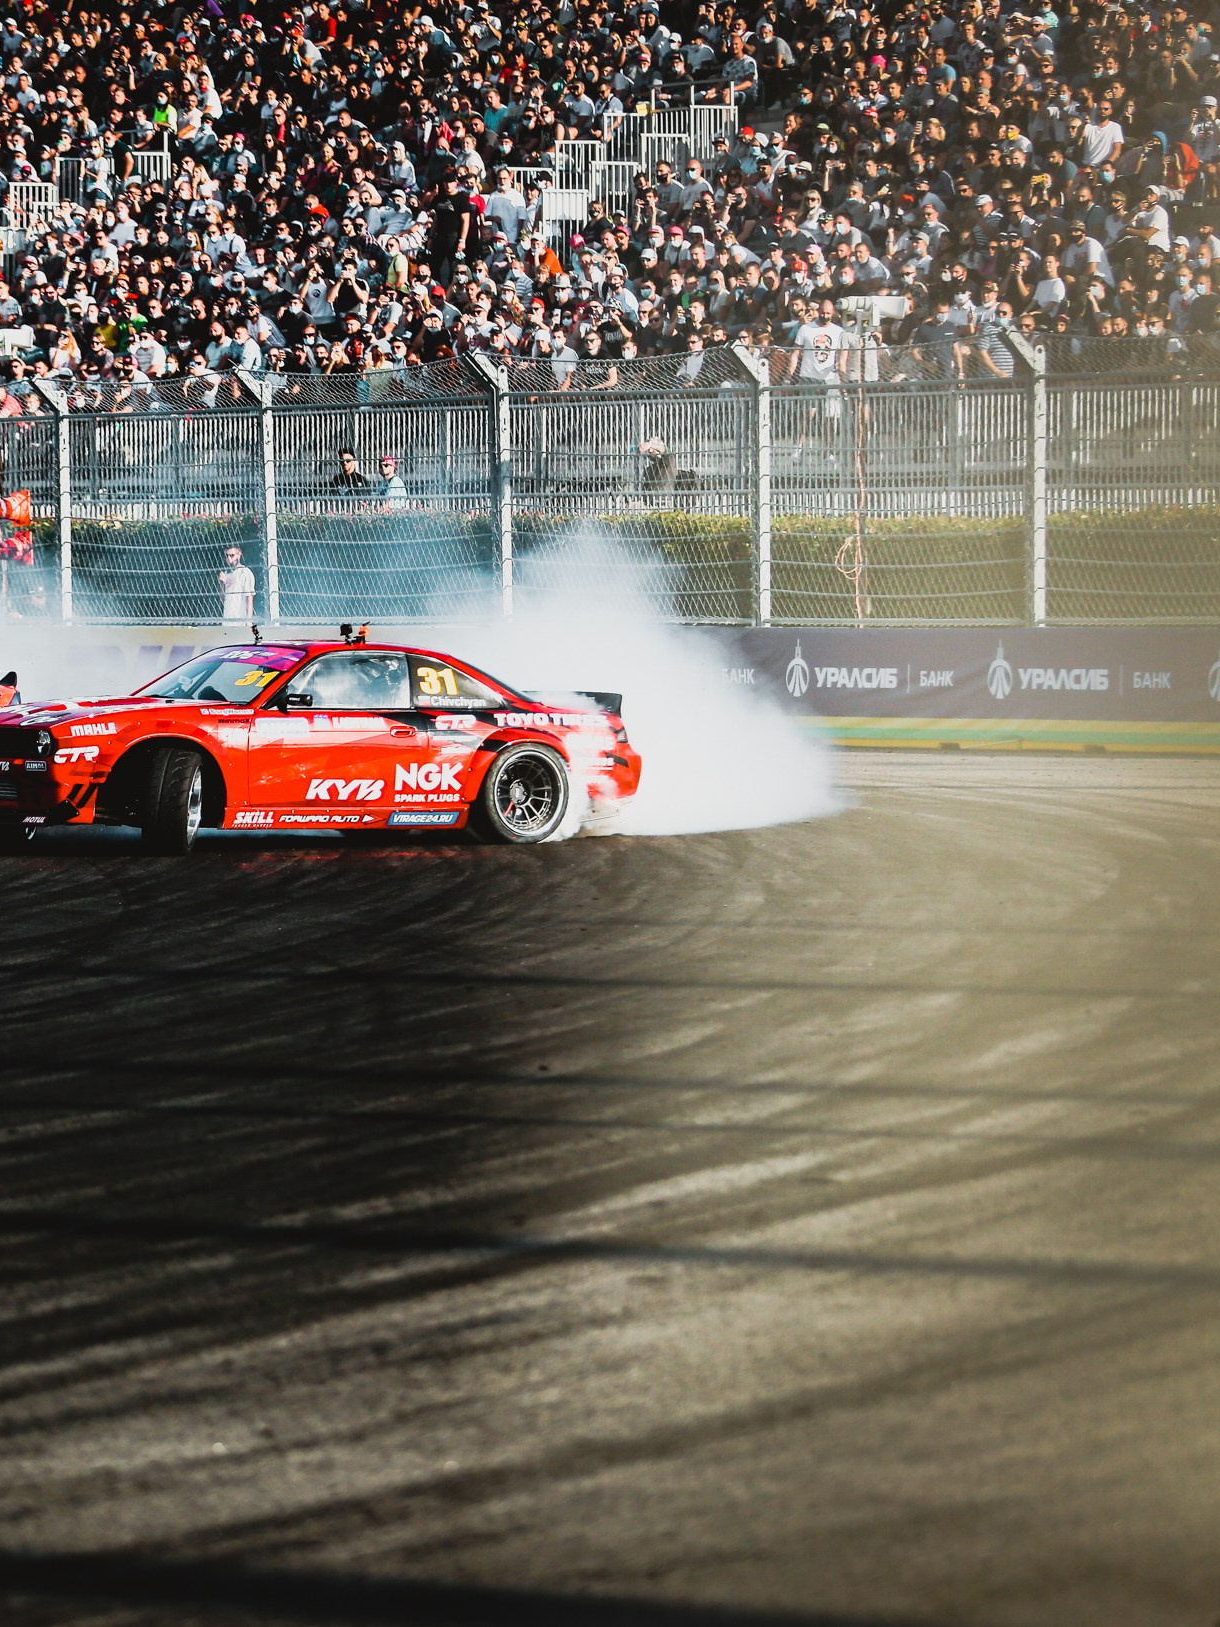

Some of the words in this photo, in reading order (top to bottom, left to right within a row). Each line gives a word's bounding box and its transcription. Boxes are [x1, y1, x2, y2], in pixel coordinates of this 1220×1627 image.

[235, 670, 280, 688] 31
[416, 666, 459, 695] 31
[814, 666, 898, 690] УРАЛСИБ
[919, 670, 955, 687] БАНК
[1018, 667, 1109, 691] УРАЛСИБ
[1133, 671, 1172, 690] БАНК
[430, 696, 487, 709] Chivchyan
[493, 712, 548, 727] TOYO
[550, 712, 608, 727] TIRES
[70, 722, 117, 737] MAHLE
[54, 745, 100, 763] CTR
[394, 762, 464, 792] NGK
[305, 778, 385, 800] KYB
[394, 793, 426, 803] SPARK
[427, 793, 461, 803] PLUGS
[23, 816, 46, 824] MOTUL
[279, 815, 330, 823] FORWARD
[330, 815, 360, 823] AUTO
[392, 814, 453, 824] VIRAGE24.RU
